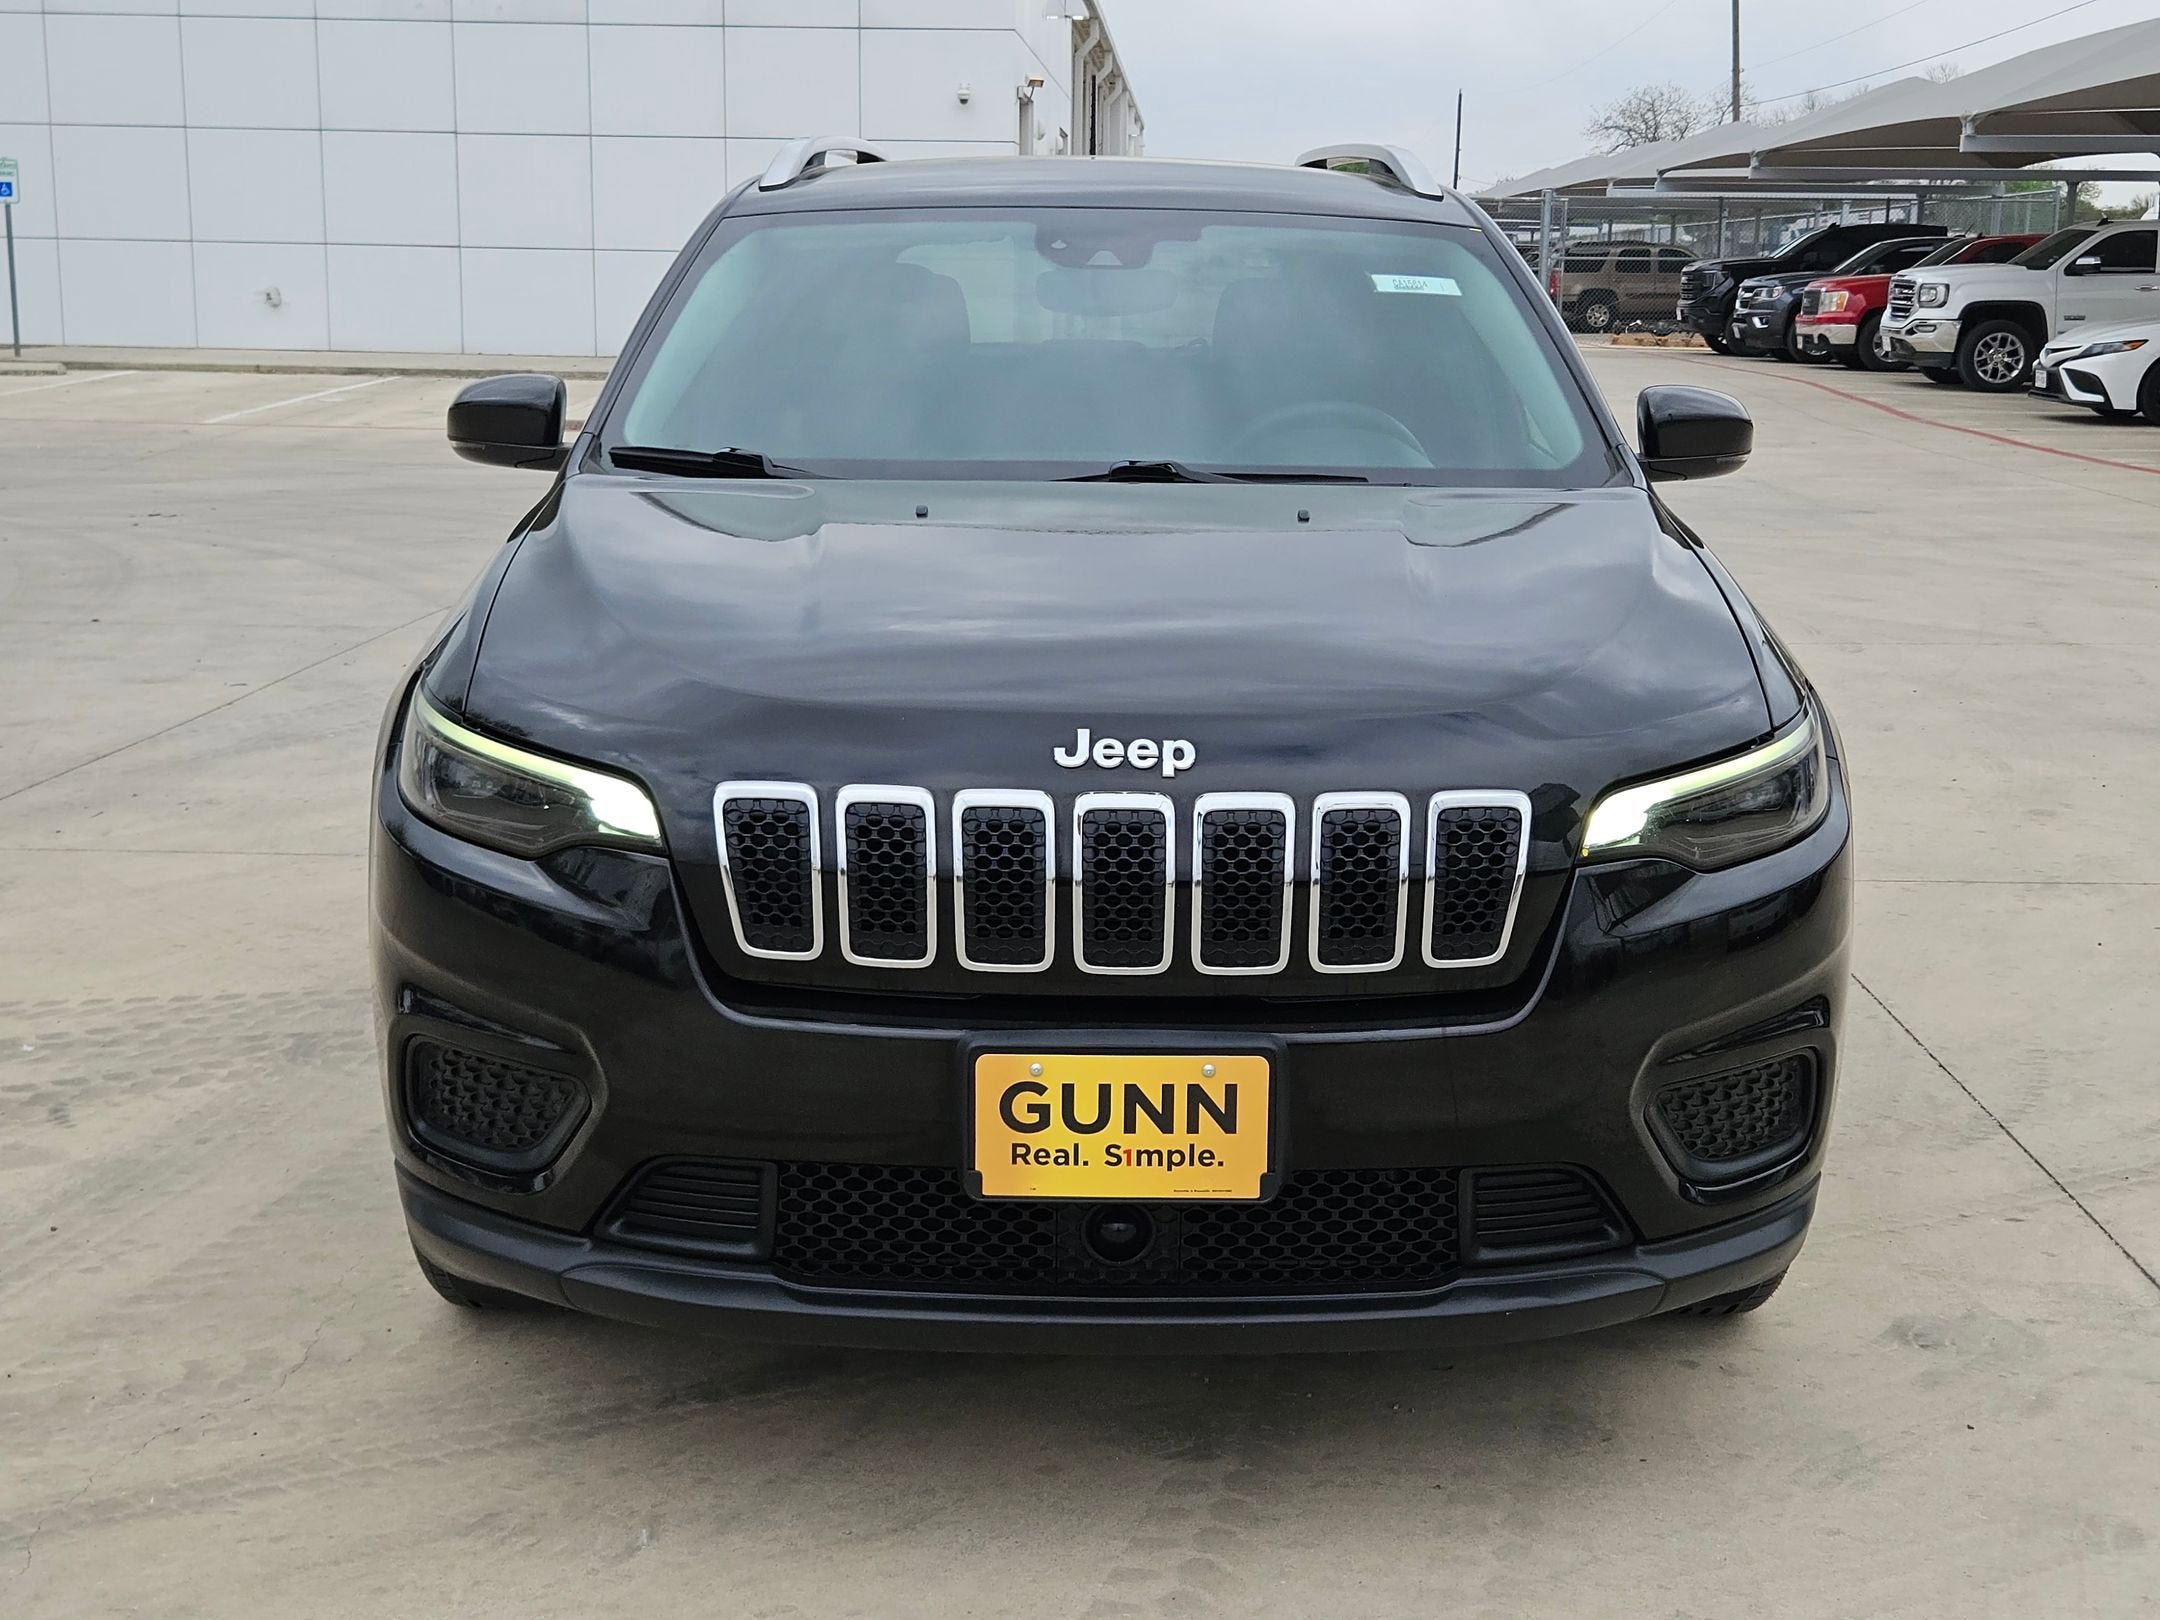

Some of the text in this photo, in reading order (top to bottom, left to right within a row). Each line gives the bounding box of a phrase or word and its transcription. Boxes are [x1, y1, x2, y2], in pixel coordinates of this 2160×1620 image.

[1053, 728, 1196, 778] Jeep
[998, 1080, 1238, 1135] GUNN
[1011, 1142, 1089, 1167] Real.
